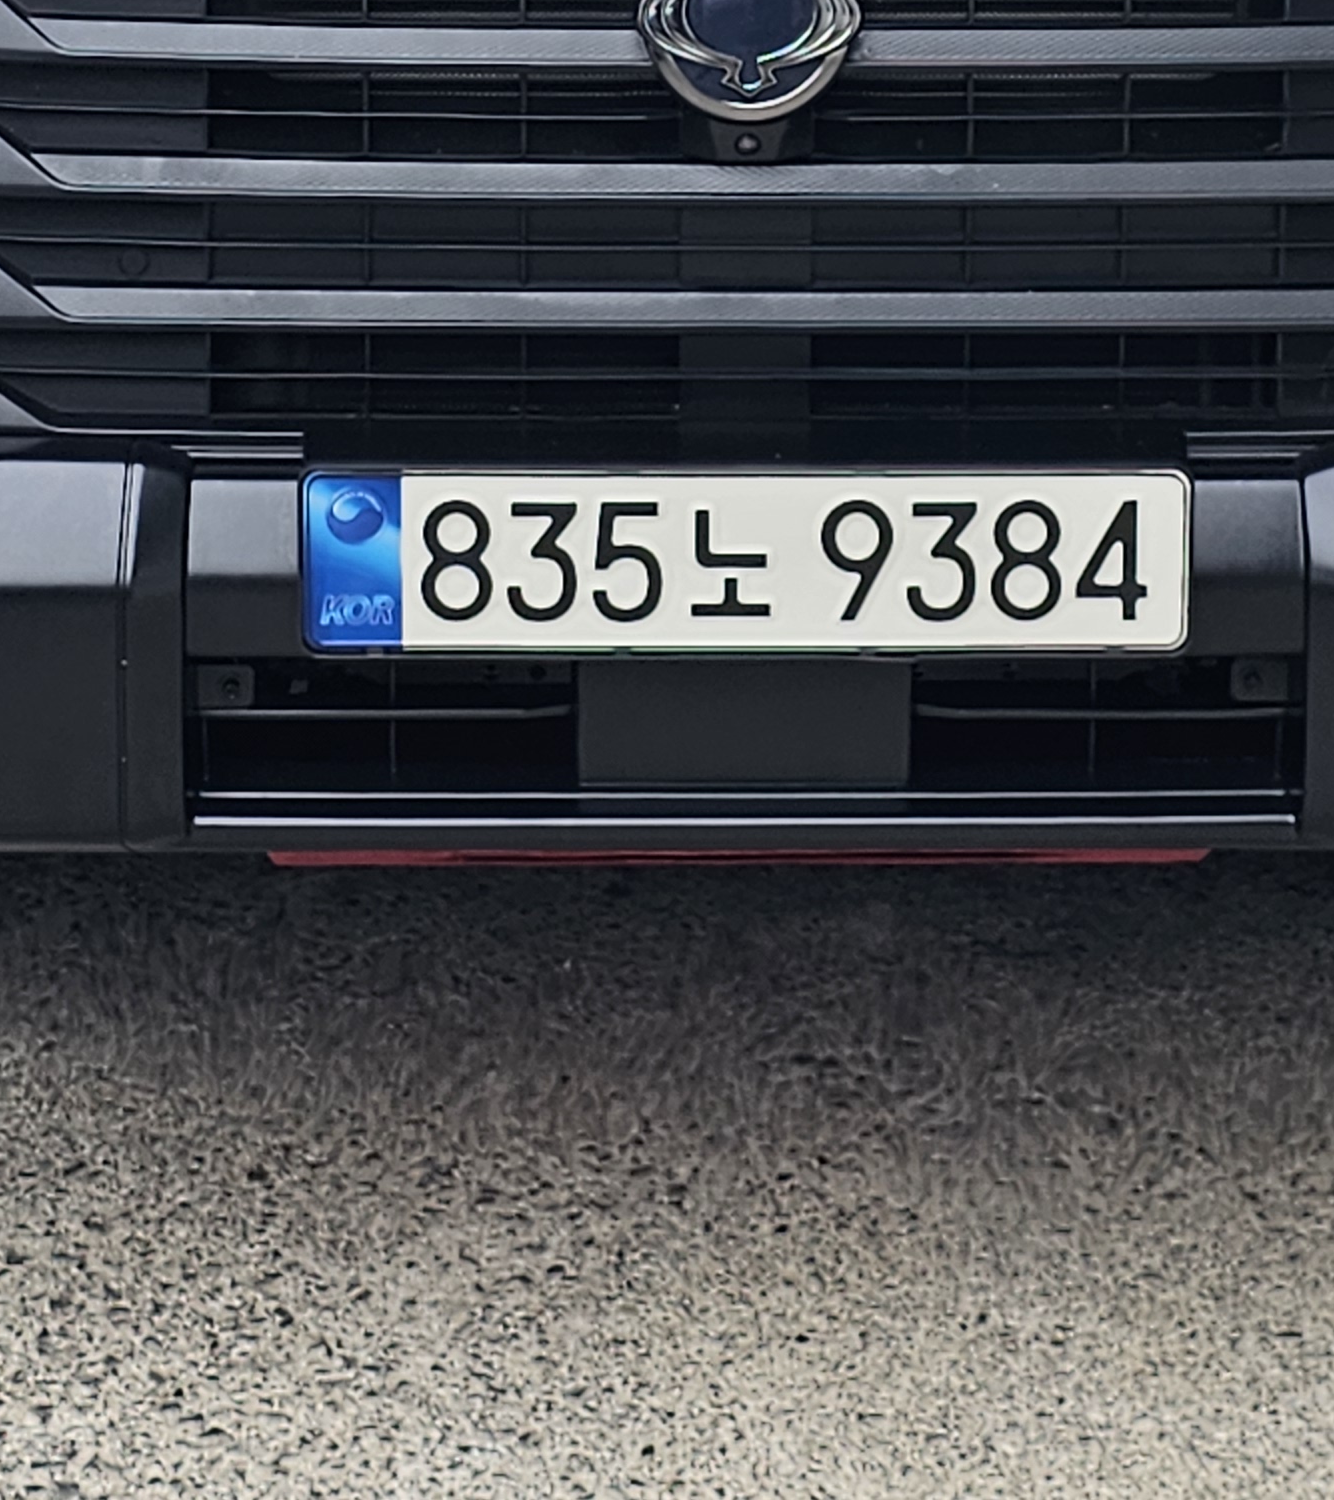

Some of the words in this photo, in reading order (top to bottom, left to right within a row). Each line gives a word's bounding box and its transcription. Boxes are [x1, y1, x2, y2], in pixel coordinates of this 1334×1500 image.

[419, 498, 772, 623] 835노
[819, 498, 1148, 622] 9384
[319, 593, 396, 627] KOR
